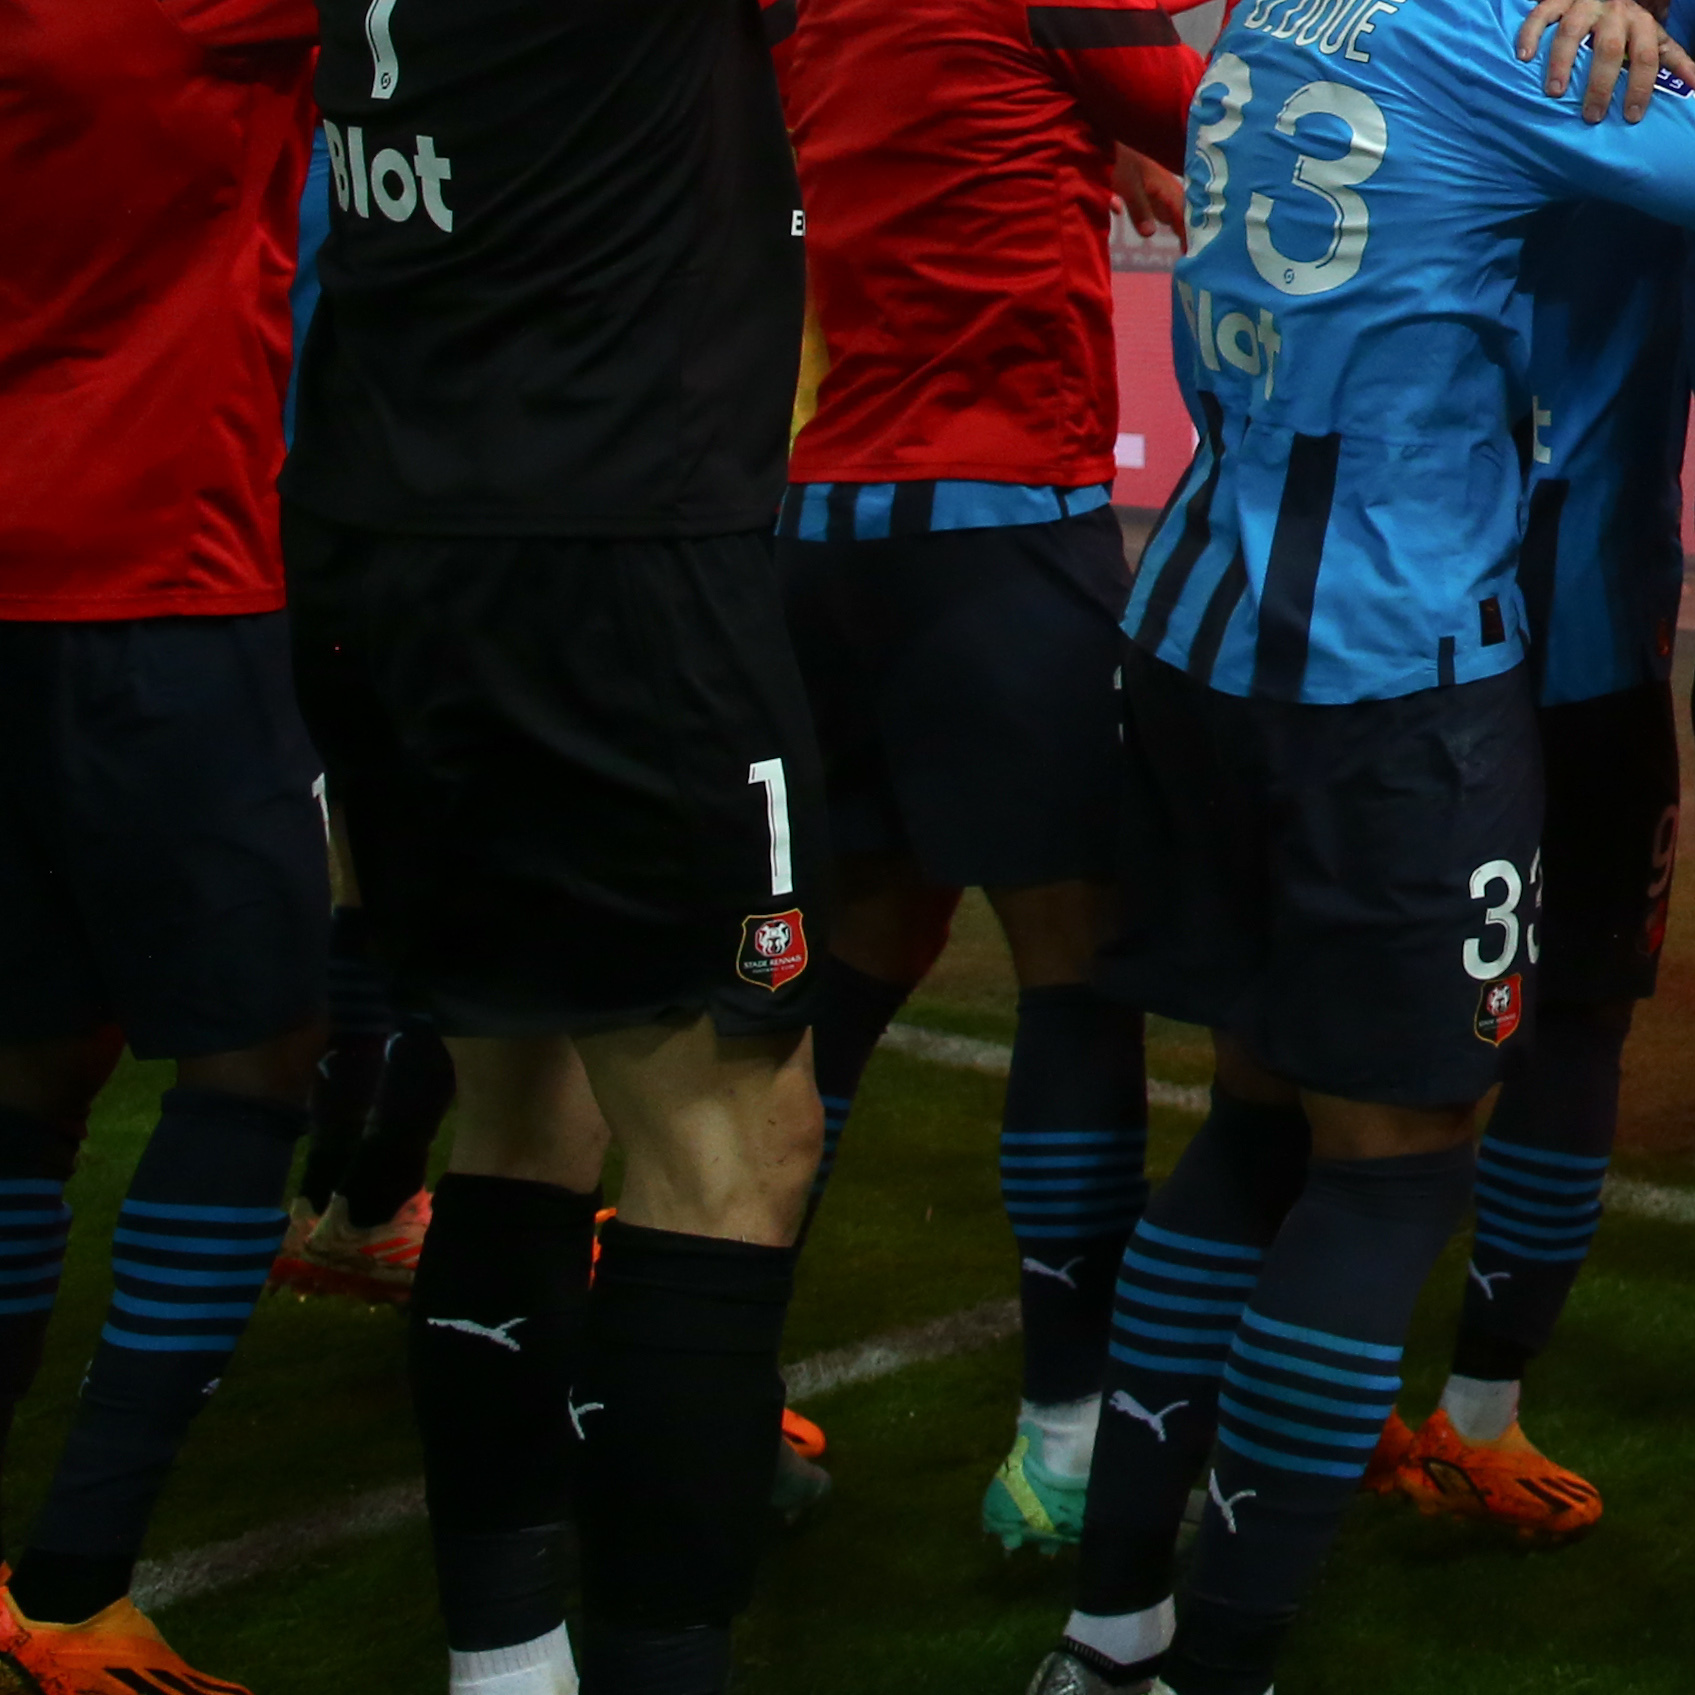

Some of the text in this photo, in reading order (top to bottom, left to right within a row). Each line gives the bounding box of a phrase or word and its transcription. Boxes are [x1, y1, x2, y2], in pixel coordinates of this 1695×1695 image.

[322, 118, 454, 233] Blot
[1179, 280, 1282, 401] lot
[748, 757, 793, 896] 1
